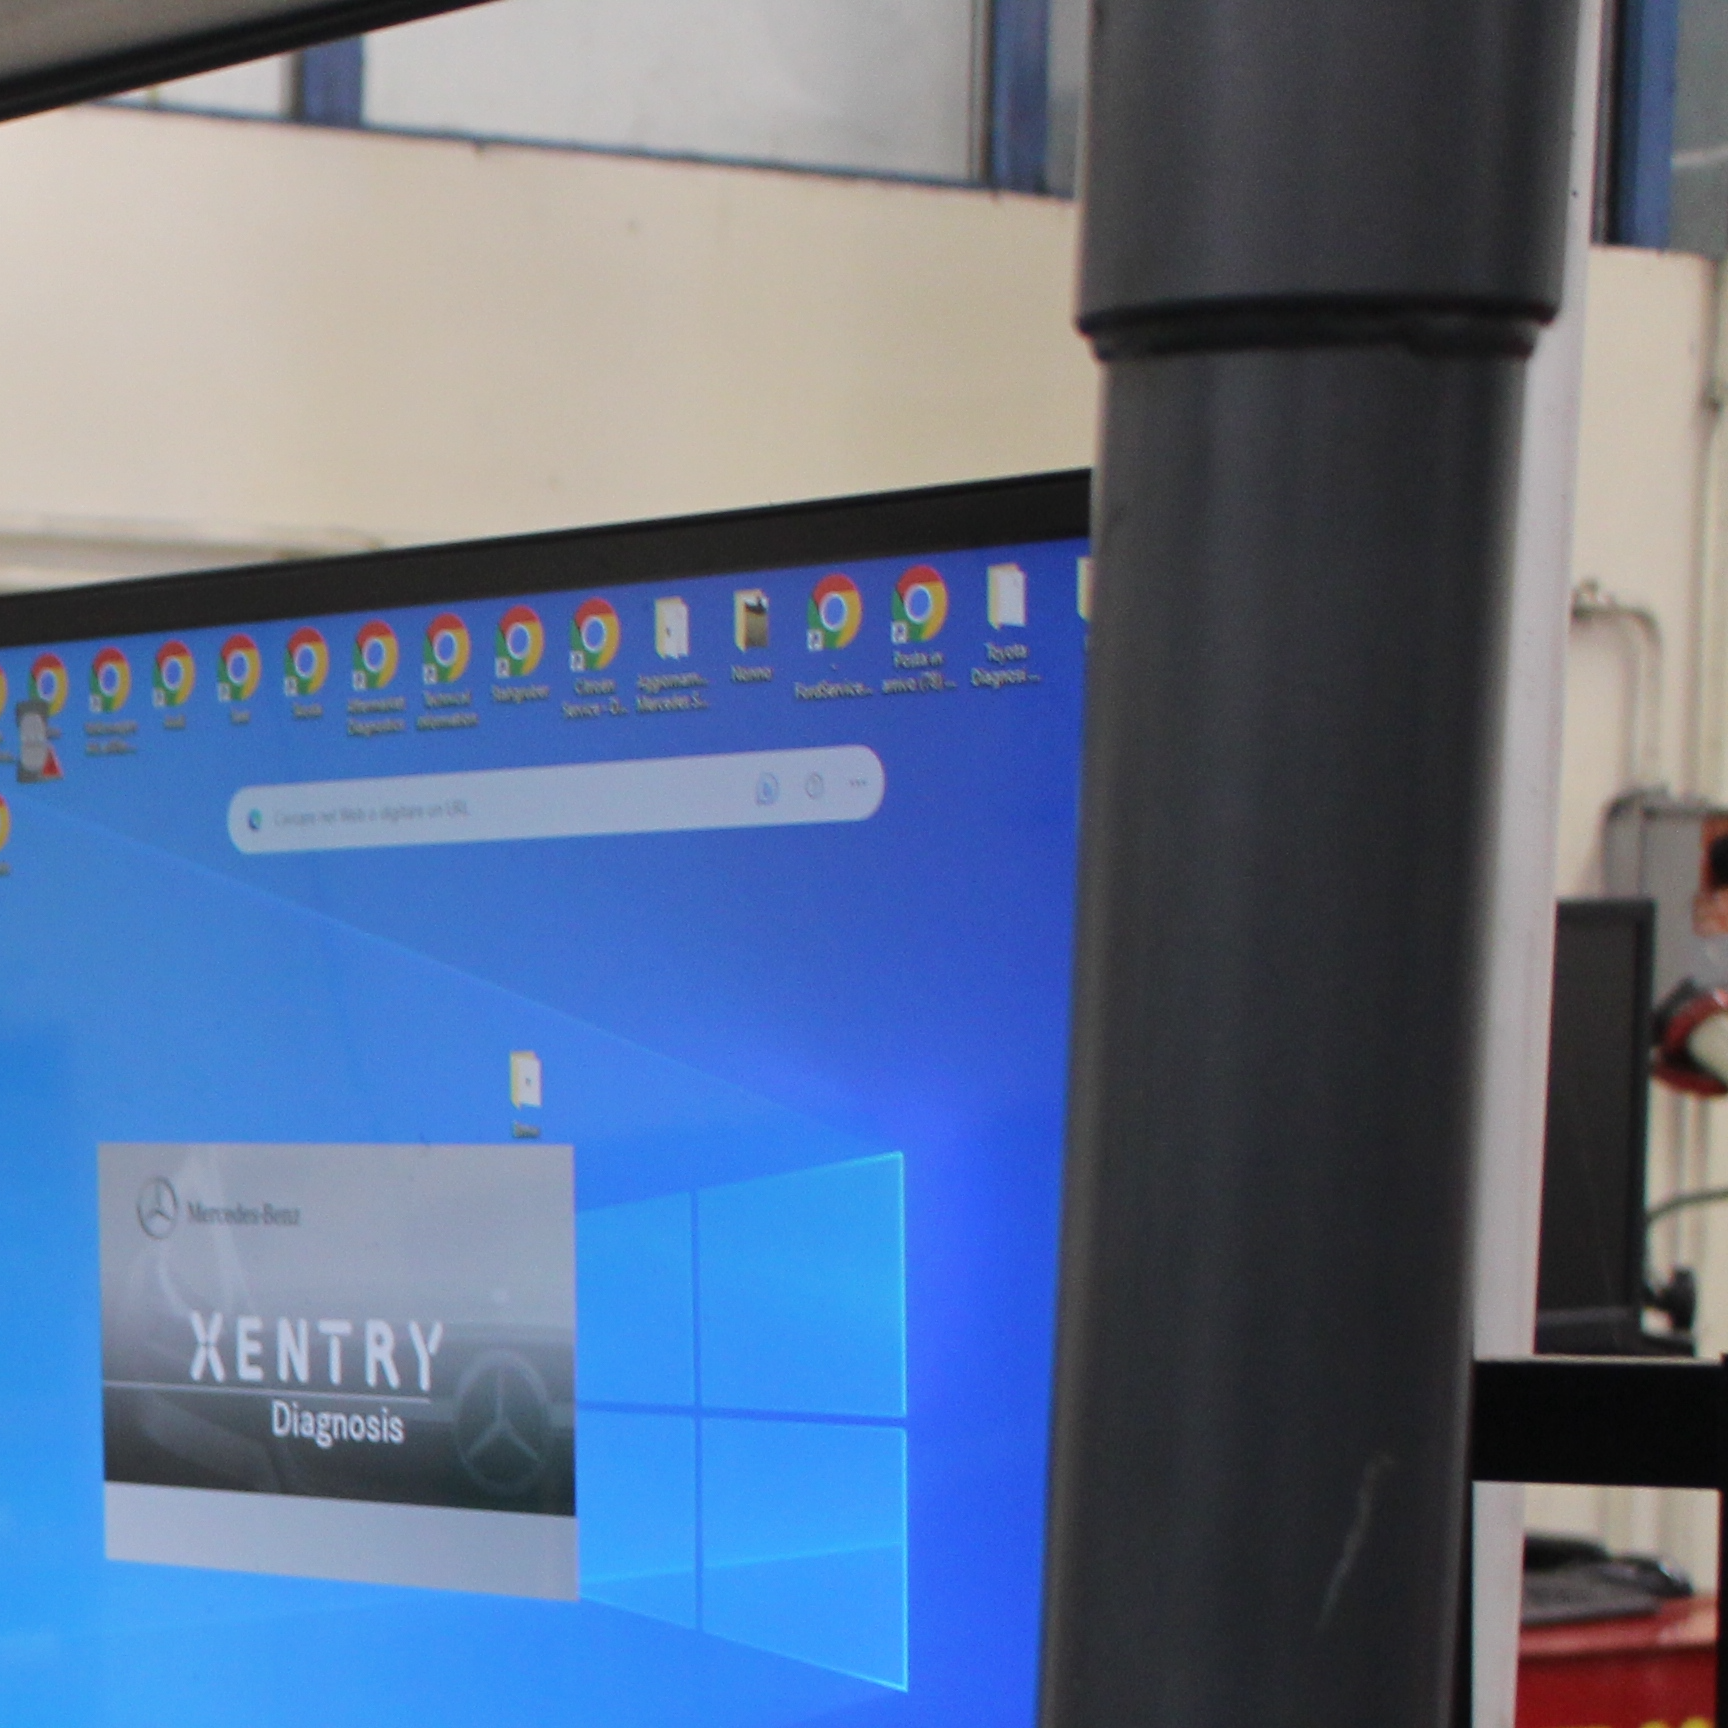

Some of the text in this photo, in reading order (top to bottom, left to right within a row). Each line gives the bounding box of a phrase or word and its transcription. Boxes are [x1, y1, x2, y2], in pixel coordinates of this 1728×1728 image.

[187, 1200, 301, 1227] Mercedes-Benz
[189, 1310, 443, 1392] XENTRY
[271, 1399, 405, 1448] Diagnosis
